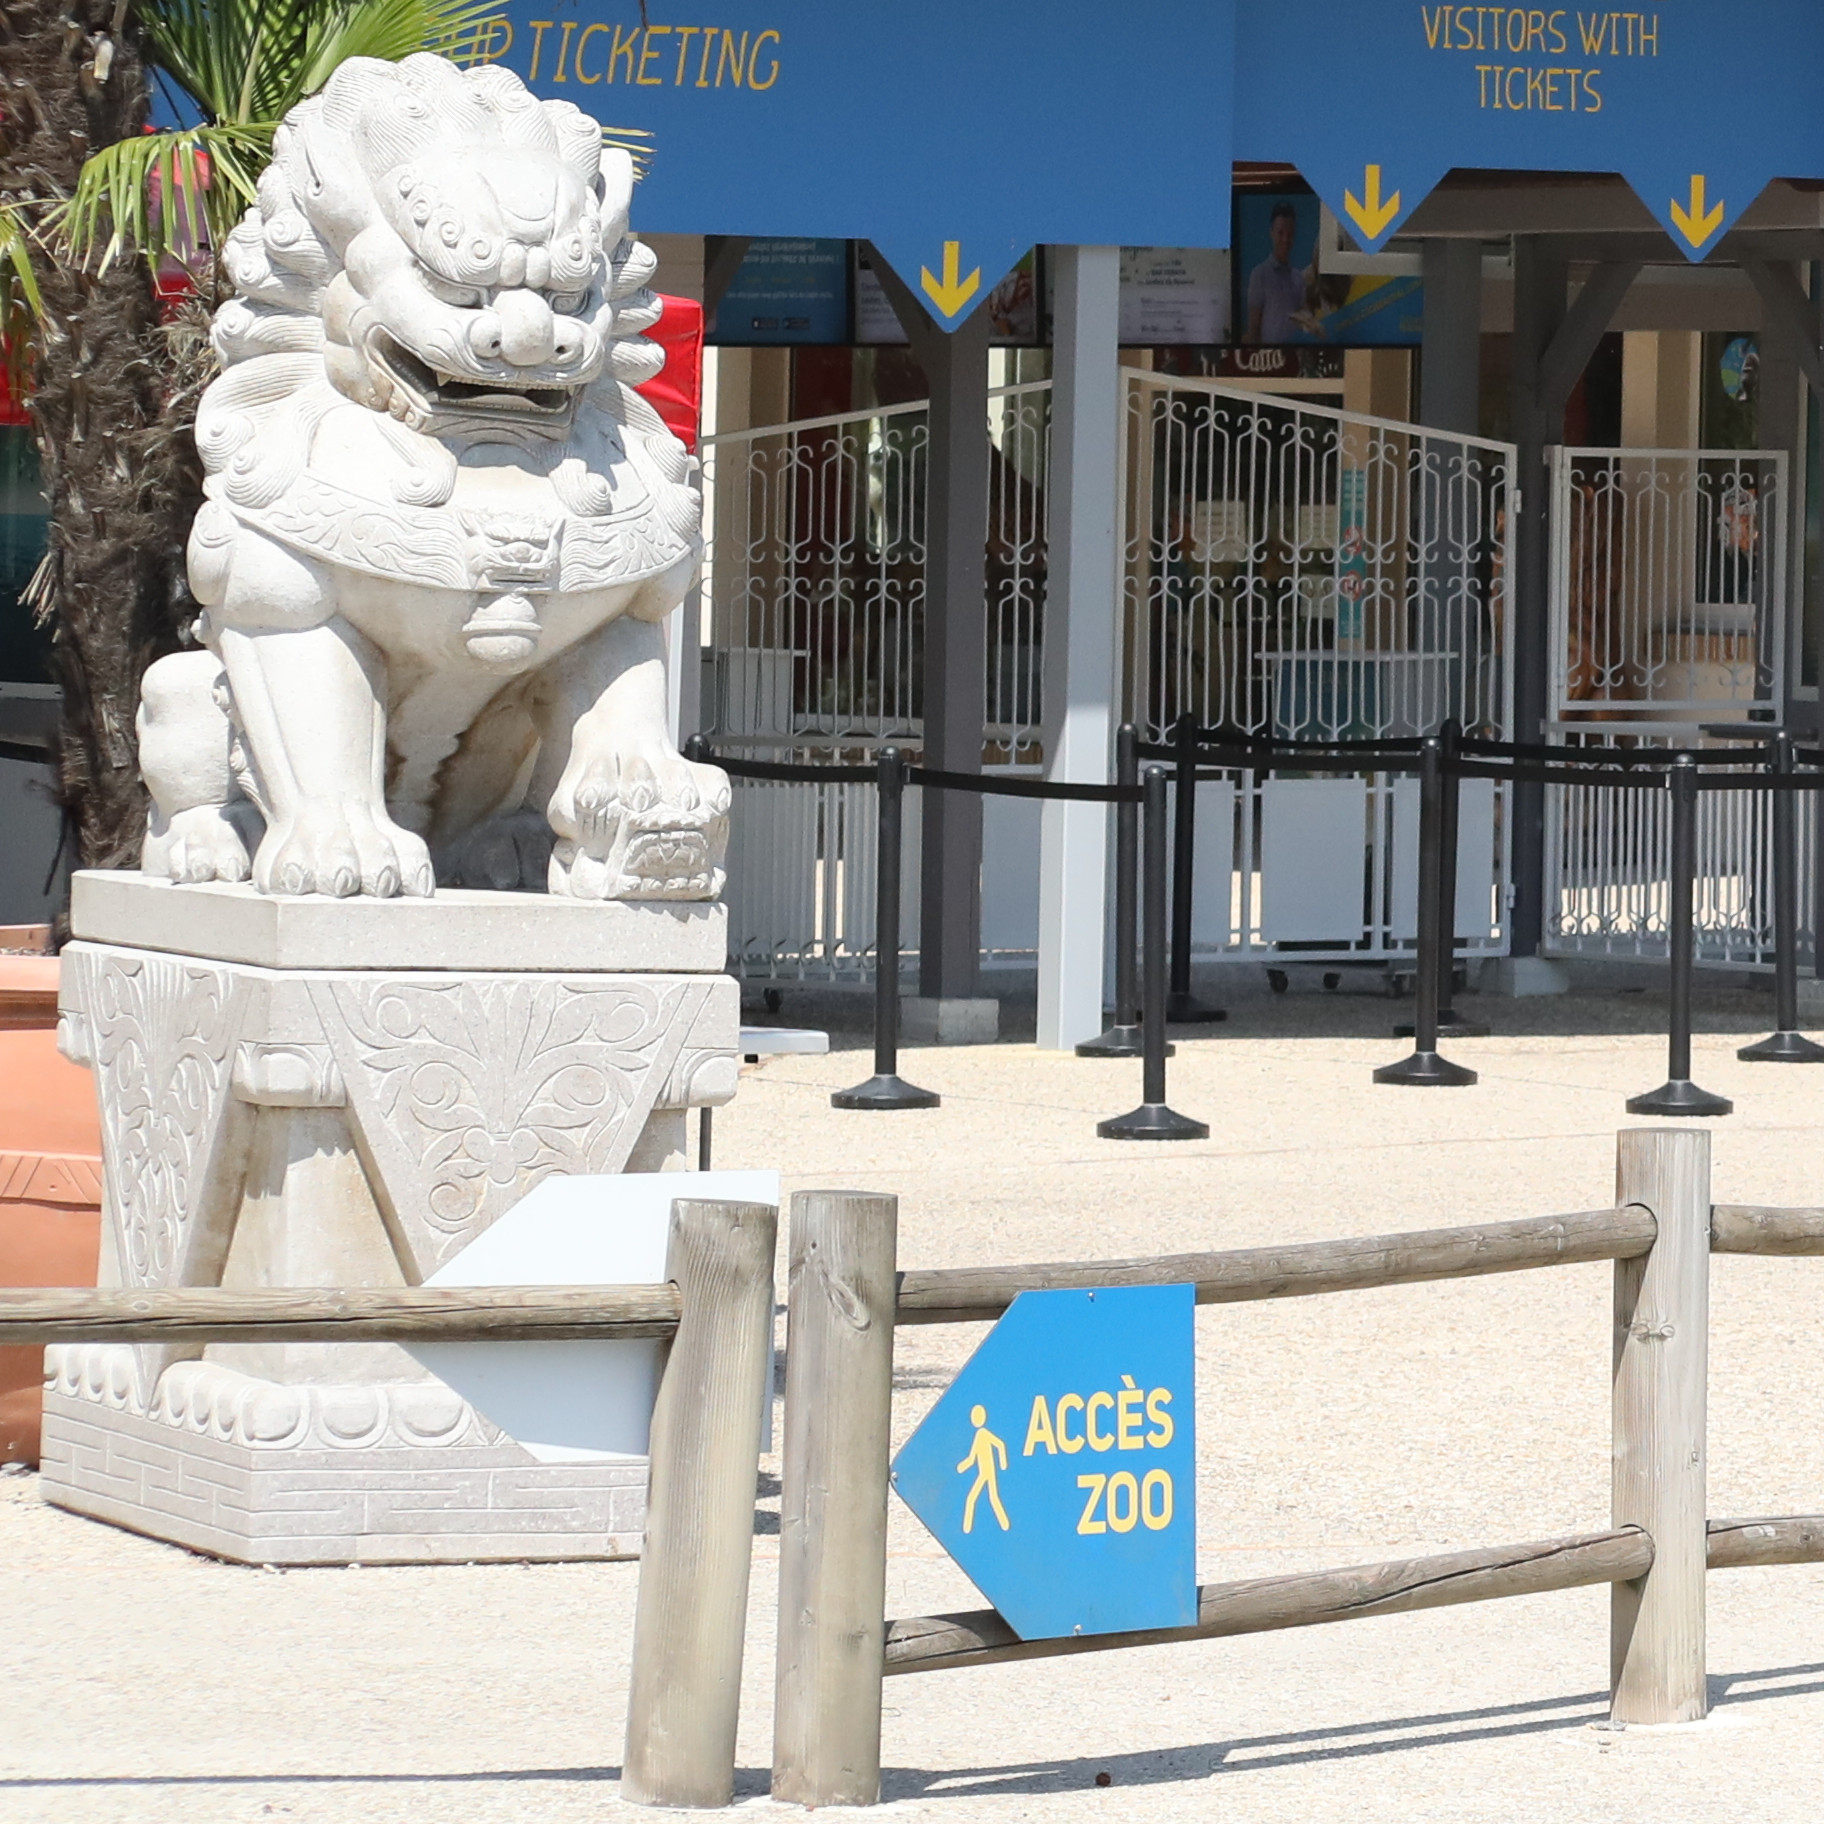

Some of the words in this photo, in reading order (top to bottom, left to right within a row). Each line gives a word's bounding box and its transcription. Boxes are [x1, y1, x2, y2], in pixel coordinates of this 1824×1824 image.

[530, 19, 781, 90] TICKETING
[1421, 6, 1567, 53] VISITORS
[1577, 12, 1658, 56] WITH
[1474, 65, 1602, 113] TICKETS
[1022, 1374, 1174, 1457] ACCÈS
[1076, 1469, 1173, 1535] ZOO
